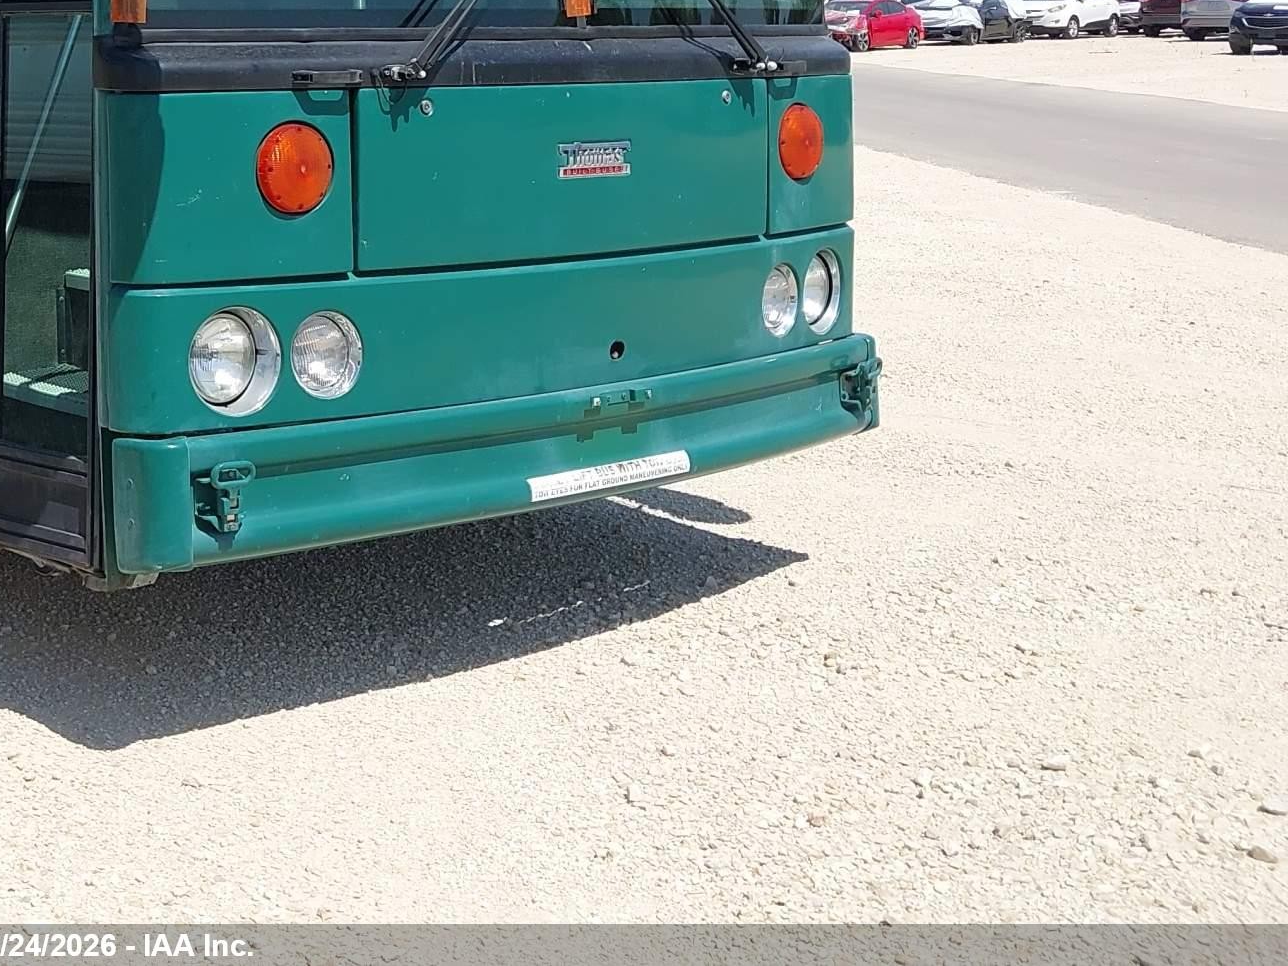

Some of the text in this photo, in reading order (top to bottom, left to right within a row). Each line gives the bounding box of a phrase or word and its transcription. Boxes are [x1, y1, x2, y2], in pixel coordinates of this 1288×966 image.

[558, 141, 631, 169] Thomas
[615, 460, 641, 474] WITH
[584, 480, 600, 490] FLAT
[601, 474, 629, 487] GROUND
